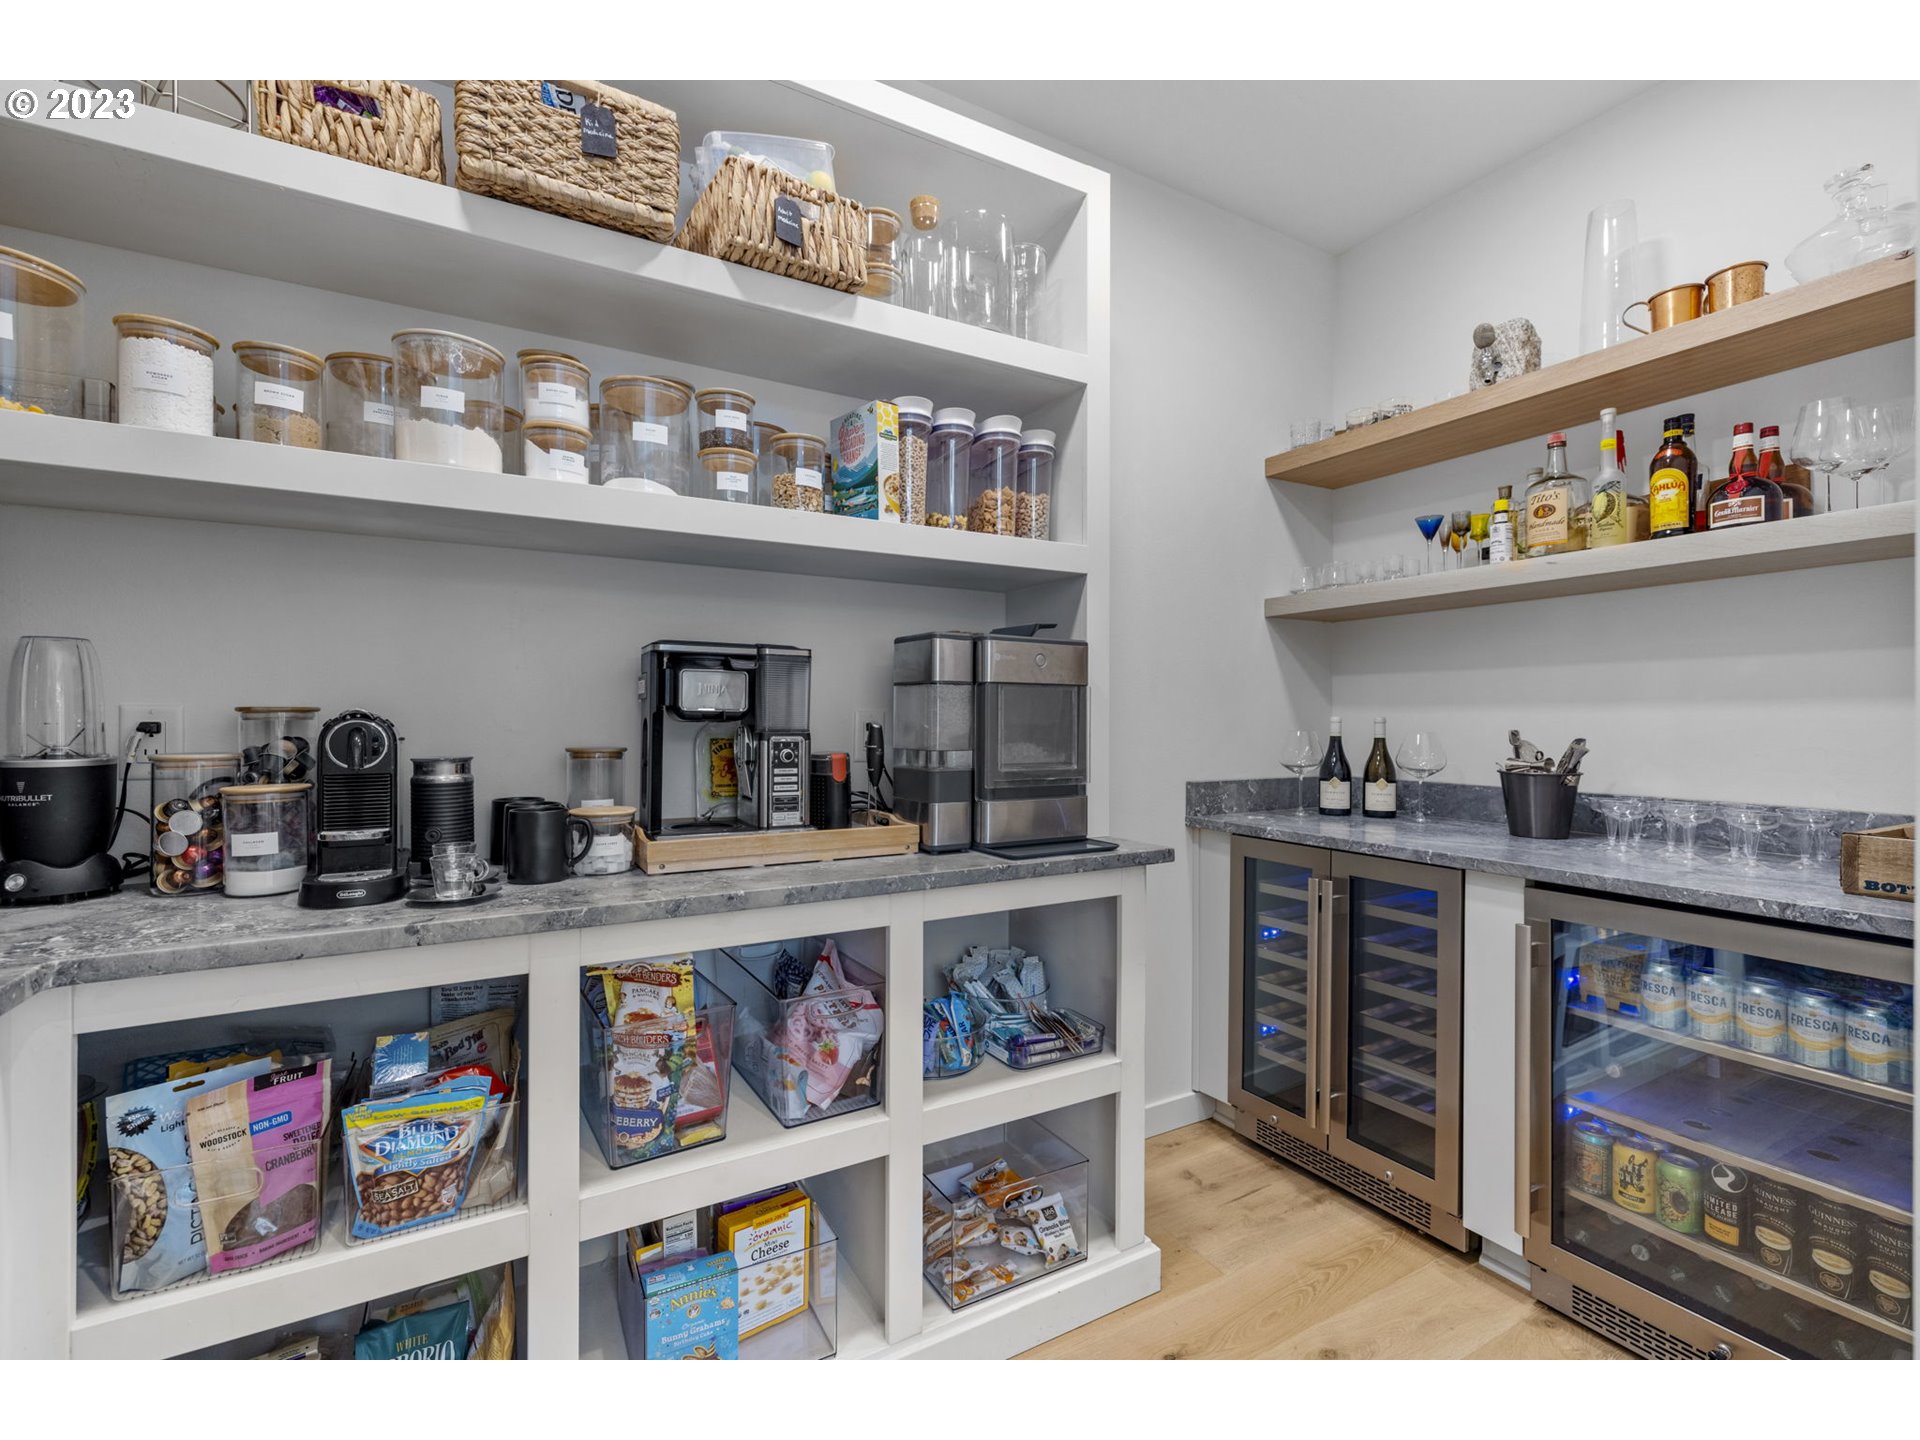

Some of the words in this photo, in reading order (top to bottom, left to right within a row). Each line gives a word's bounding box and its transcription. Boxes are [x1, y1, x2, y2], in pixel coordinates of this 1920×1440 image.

[1530, 491, 1561, 505] Tito's
[631, 988, 660, 997] PANCAKE
[1737, 1000, 1783, 1021] FRESCA
[1791, 1012, 1839, 1034] FRESCA
[273, 1072, 303, 1085] FRUIT
[374, 1112, 404, 1120] LOW
[410, 1105, 464, 1115] SODIUM
[252, 1113, 289, 1133] NON-GMO
[282, 1121, 321, 1141] SWEETENED
[400, 1123, 438, 1139] BLUE
[199, 1128, 248, 1149] WOODSTOCK
[374, 1125, 459, 1157] DIAMOND
[382, 1158, 419, 1173] Lightly
[419, 1152, 453, 1166] Salted
[374, 1187, 393, 1201] SEA
[393, 1182, 416, 1196] SALT
[1043, 1208, 1056, 1217] 365
[1808, 1204, 1858, 1228] GUINNESS
[752, 1220, 793, 1242] organic
[1038, 1223, 1059, 1234] Granola
[1813, 1219, 1851, 1235] DRAUGHT
[751, 1239, 790, 1262] Cheese
[661, 1330, 689, 1344] Bunny
[690, 1318, 726, 1334] Grahams
[396, 1333, 429, 1352] WHITE
